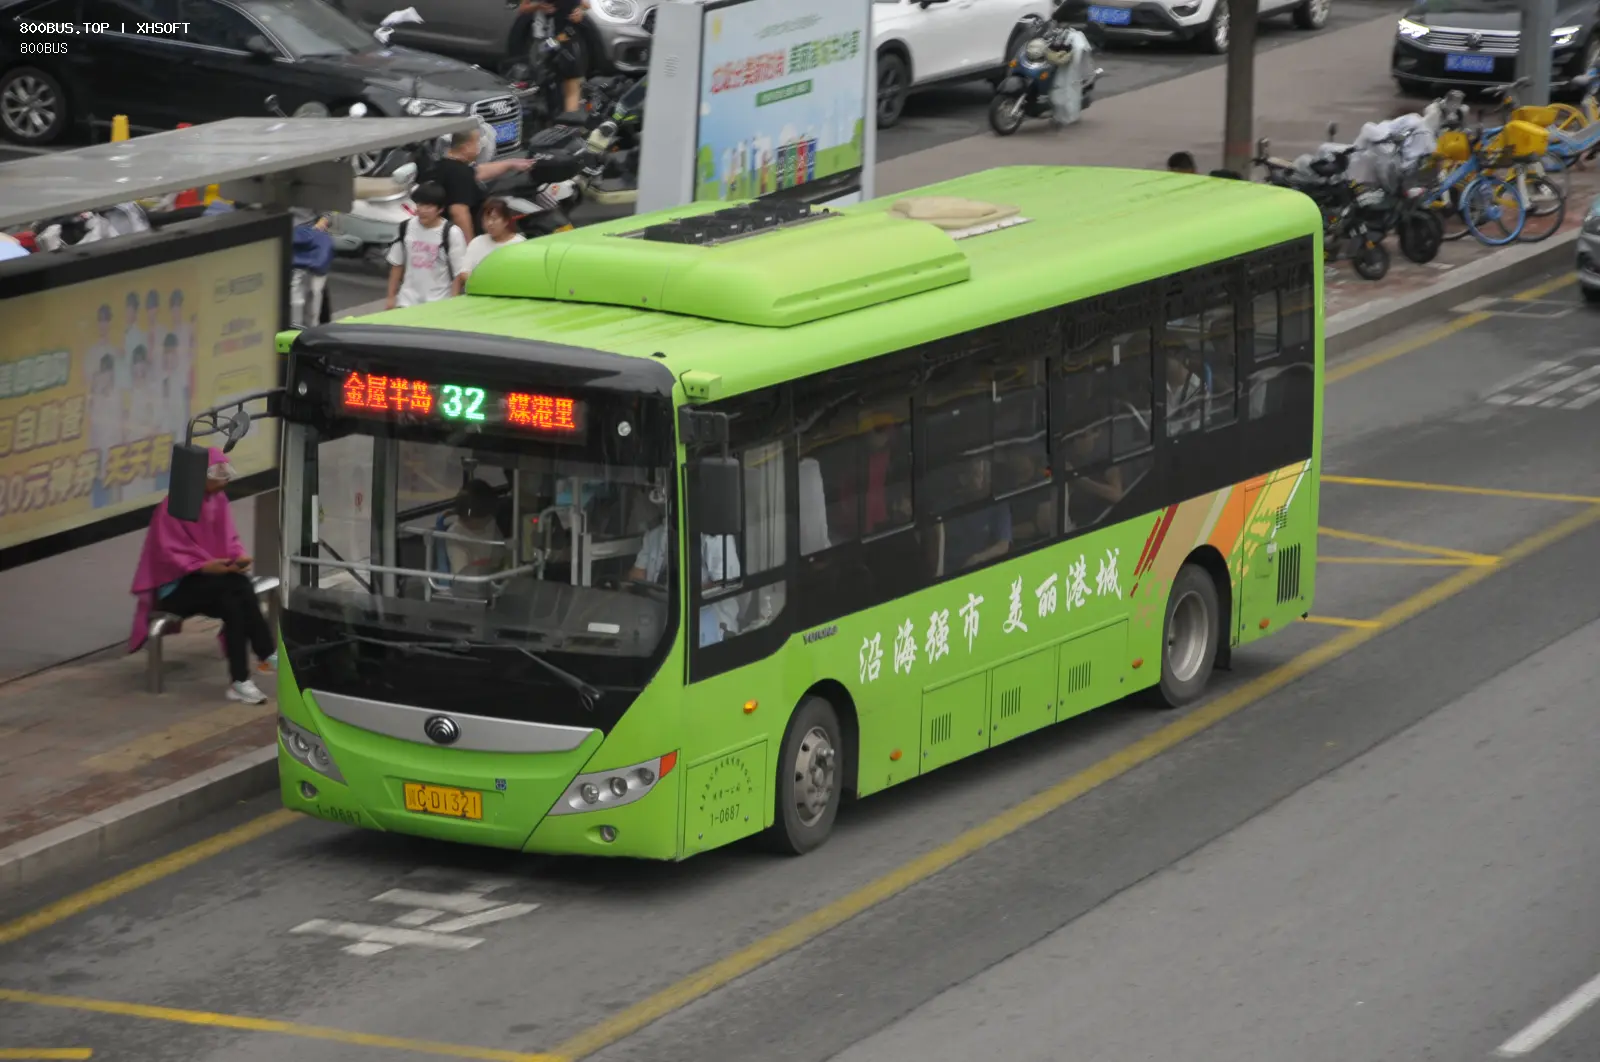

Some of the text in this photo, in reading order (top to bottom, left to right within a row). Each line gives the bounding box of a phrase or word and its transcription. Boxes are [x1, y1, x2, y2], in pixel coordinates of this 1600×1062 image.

[343, 370, 433, 415] 金屋半岛
[442, 383, 486, 421] 32
[859, 547, 1122, 685] 沿海强市 美丽港城
[711, 803, 740, 827] 1-0687
